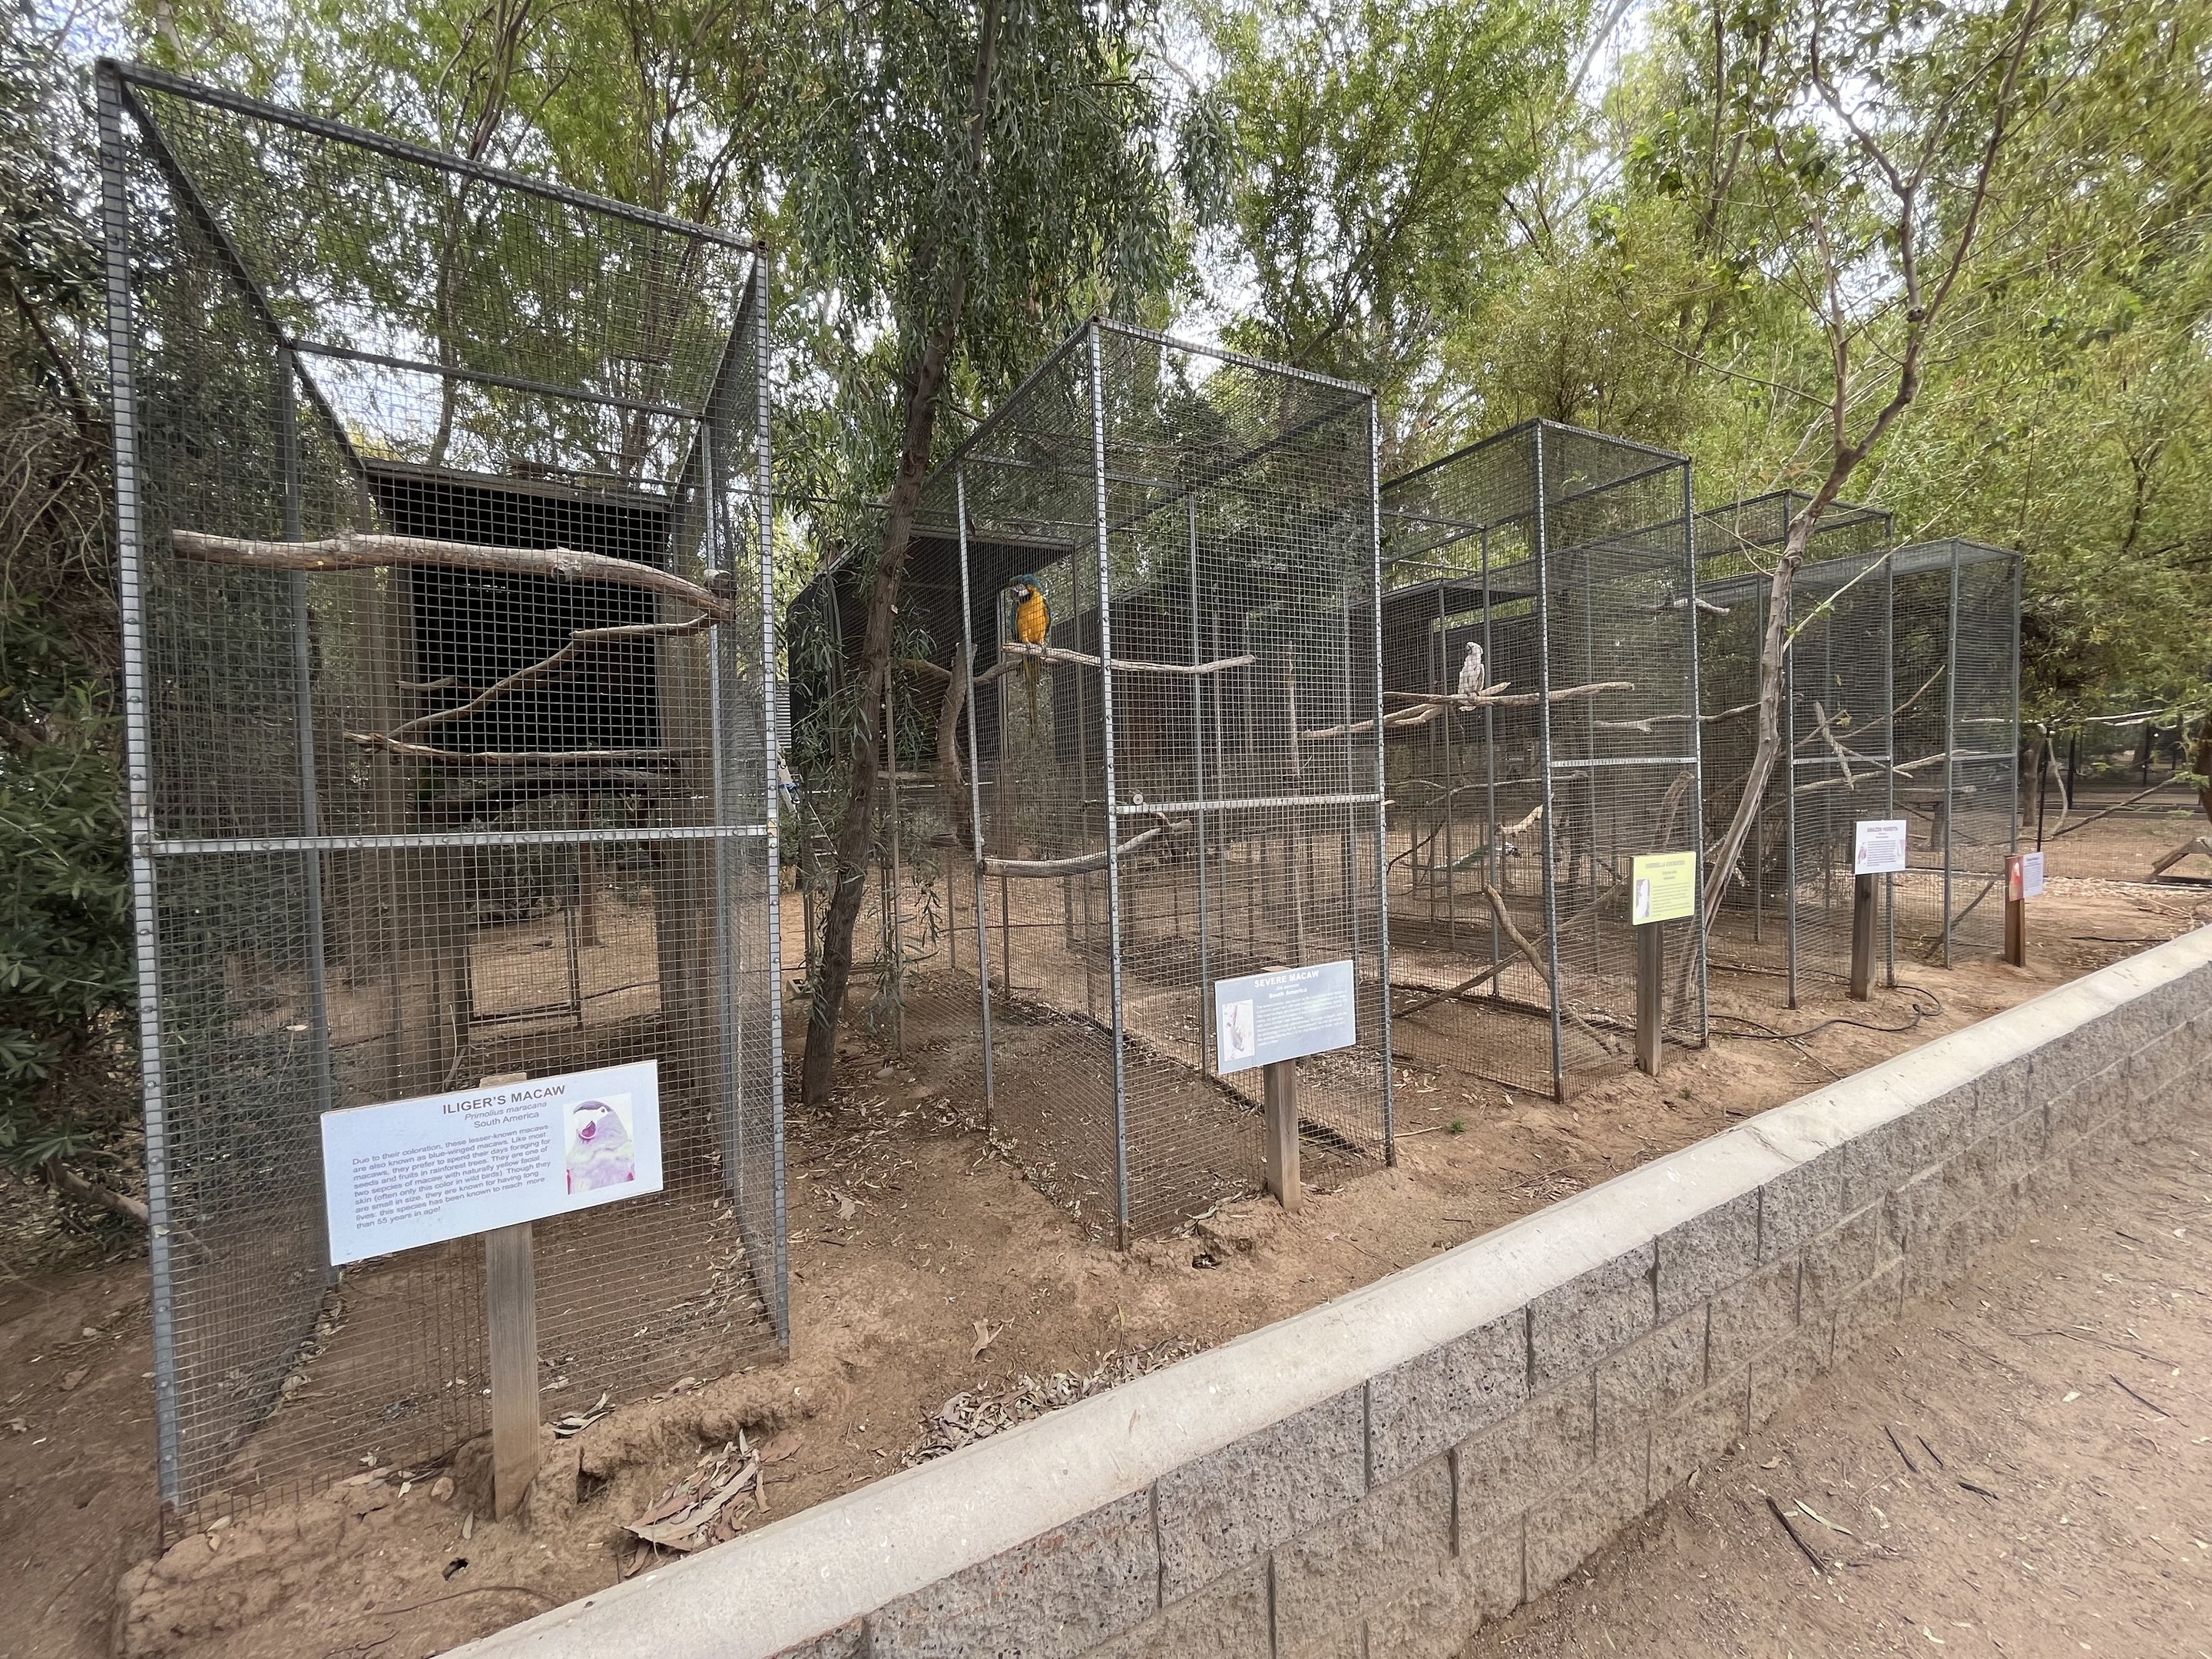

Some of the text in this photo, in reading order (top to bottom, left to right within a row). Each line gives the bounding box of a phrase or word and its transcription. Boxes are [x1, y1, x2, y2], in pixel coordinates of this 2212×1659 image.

[1254, 975, 1287, 988] SEVERE
[1289, 971, 1320, 982] MACAW
[442, 1085, 566, 1114] ILIGER'S MACAW
[465, 1101, 547, 1121] Primolius maracana
[474, 1112, 539, 1128] South America
[445, 1140, 466, 1149] these
[469, 1131, 518, 1144] lesser-known
[519, 1125, 548, 1134] macaws
[389, 1157, 415, 1166] known
[429, 1146, 475, 1159] blue-winged
[412, 1161, 435, 1171] prefer
[447, 1154, 470, 1164] spend
[510, 1141, 539, 1151] foraging
[354, 1180, 379, 1189] seeds
[399, 1171, 419, 1180] fruits
[430, 1163, 466, 1174] rainforest
[415, 1176, 443, 1185] macaw
[462, 1165, 494, 1176] naturally
[496, 1160, 519, 1171] yellow
[521, 1155, 540, 1164] facial
[372, 1201, 393, 1210] small
[459, 1183, 484, 1192] known
[498, 1174, 522, 1184] having
[374, 1193, 398, 1203] (often
[507, 1164, 534, 1174] Though
[396, 1202, 427, 1213] species
[445, 1194, 465, 1203] been
[467, 1189, 491, 1197] known
[502, 1182, 522, 1190] reach
[356, 1221, 375, 1230] than
[389, 1213, 412, 1223] years
[424, 1207, 441, 1215] age!
